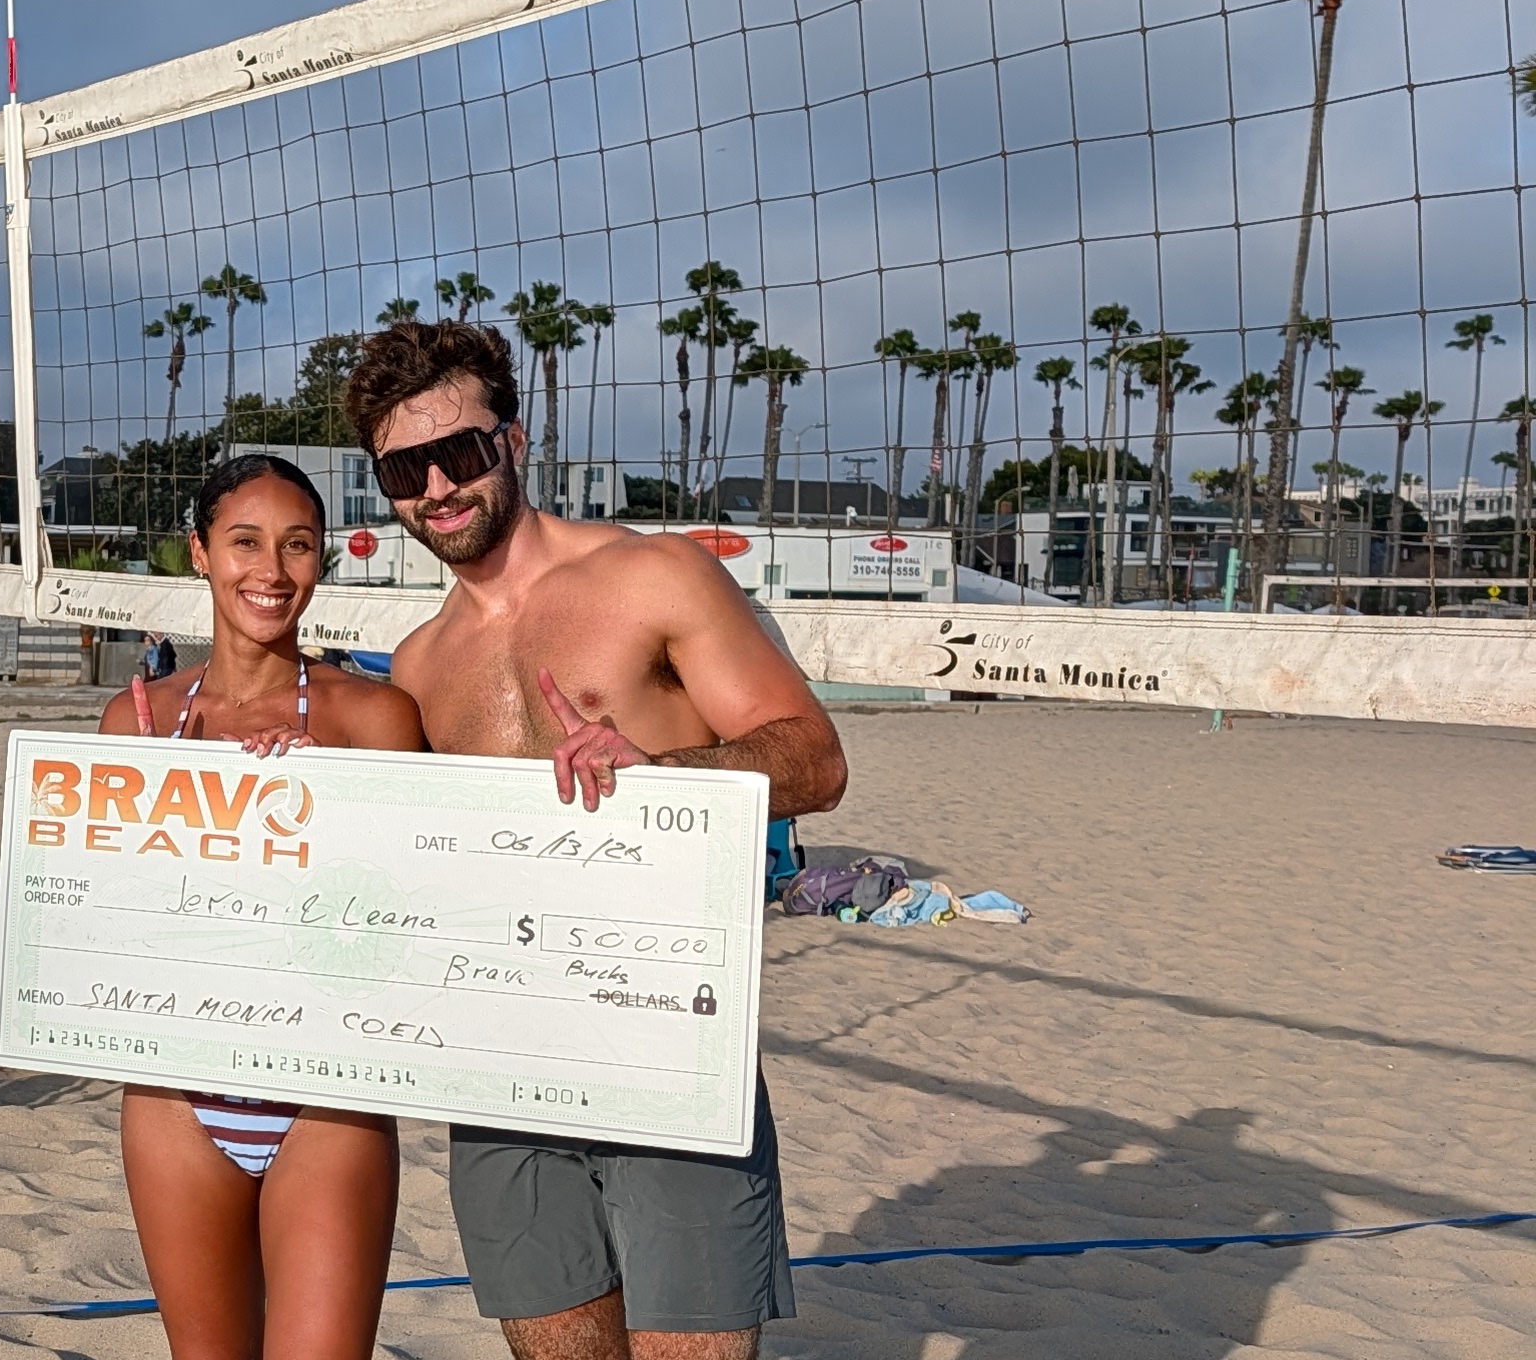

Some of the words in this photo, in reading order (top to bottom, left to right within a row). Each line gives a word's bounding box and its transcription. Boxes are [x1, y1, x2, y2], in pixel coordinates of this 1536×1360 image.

[259, 51, 274, 66] City
[262, 65, 301, 85] Santa
[55, 126, 84, 142] Santa
[65, 603, 93, 618] Santa
[981, 634, 1008, 652] City
[1015, 634, 1034, 649] of
[972, 659, 1047, 683] Santa
[31, 759, 314, 837] BRAVO
[639, 804, 710, 834] 1001
[28, 820, 309, 868] BEACH
[415, 835, 458, 852] DATE
[25, 875, 47, 887] PAY
[49, 877, 65, 889] TO
[67, 878, 90, 892] THE
[24, 891, 65, 905] ORDER
[67, 894, 85, 907] OF
[516, 914, 535, 946] $
[565, 960, 629, 985] Bucks
[17, 989, 64, 1006] MEMO
[597, 989, 681, 1011] DOLLARS
[81, 983, 176, 1015] SANTA
[342, 1012, 445, 1048] COED
